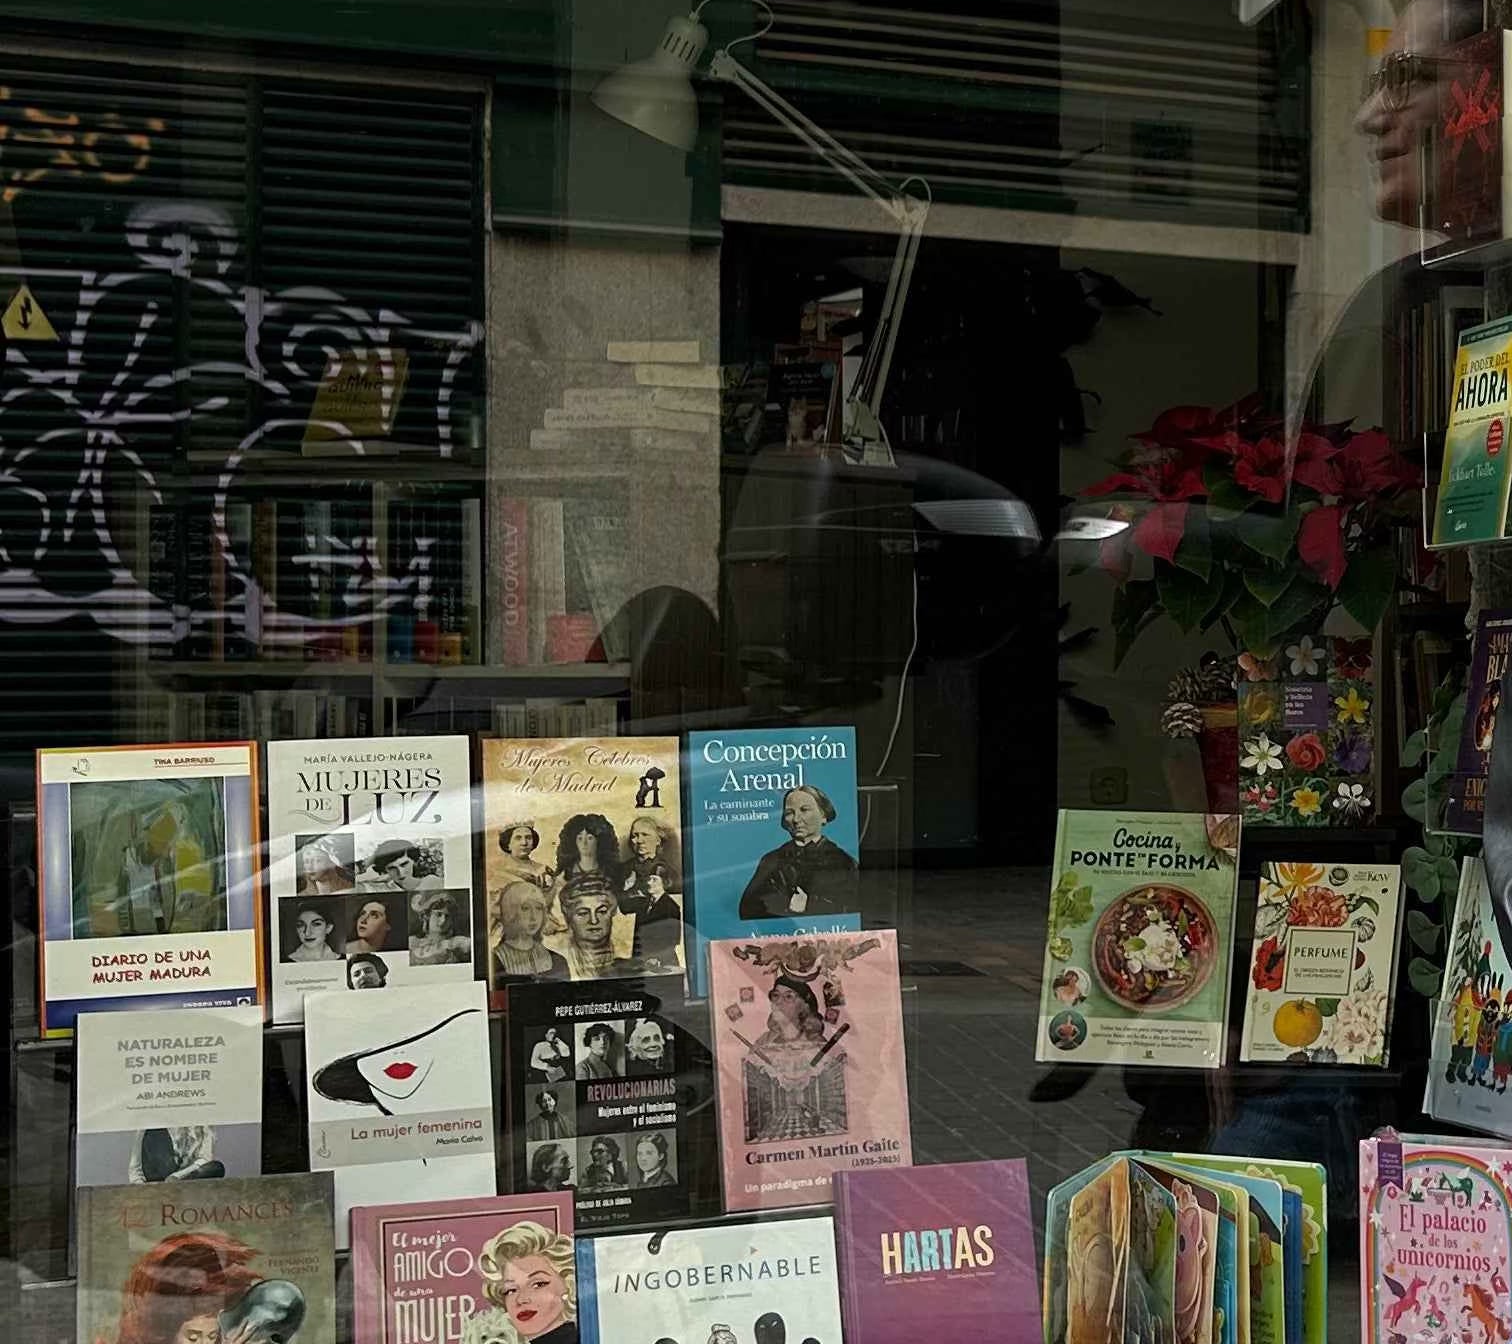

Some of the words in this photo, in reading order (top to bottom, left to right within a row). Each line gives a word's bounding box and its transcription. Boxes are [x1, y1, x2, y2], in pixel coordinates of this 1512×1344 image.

[1455, 368, 1508, 412] AHORA
[503, 519, 520, 626] ATWOOD
[304, 752, 337, 764] MARÍA
[703, 734, 847, 773] Concepción
[296, 767, 442, 793] MUJERES
[512, 778, 534, 794] de
[541, 775, 617, 794] Madrid
[719, 764, 805, 792] Arenal
[305, 798, 332, 812] DE
[338, 790, 442, 825] LUZ
[704, 799, 724, 810] La
[728, 798, 775, 810] caminante
[733, 810, 769, 822] sombra
[1113, 827, 1174, 848] Cocina
[1070, 850, 1135, 867] PONTE
[1148, 853, 1220, 871] FORMA
[92, 953, 148, 968] DIARIO
[154, 951, 173, 964] DE
[179, 949, 211, 962] UNA
[1294, 946, 1348, 959] PERFUME
[92, 969, 143, 984] MUJER
[149, 966, 211, 981] MADURA
[555, 1006, 573, 1016] PEPE
[117, 1036, 226, 1052] NATURALEZA
[125, 1055, 144, 1068] ES
[149, 1053, 218, 1067] NOMBRE
[132, 1072, 153, 1085] DE
[157, 1070, 211, 1084] MUJER
[155, 1088, 206, 1100] ANDREWS
[587, 1078, 676, 1102] REVOLUCIONARIAS
[351, 1127, 368, 1140] La
[373, 1125, 413, 1139] mujer
[417, 1118, 483, 1135] femenina
[745, 1149, 805, 1167] Carmen
[862, 1137, 901, 1155] Gaite
[744, 1183, 760, 1194] Un
[760, 1177, 813, 1194] paradigma
[815, 1175, 828, 1186] de
[1400, 1204, 1415, 1233] El
[1421, 1206, 1488, 1236] palacio
[392, 1232, 407, 1248] El
[411, 1230, 457, 1249] mejor
[881, 1225, 995, 1274] HARTAS
[1428, 1233, 1442, 1248] de
[1443, 1234, 1459, 1249] los
[394, 1247, 474, 1282] AMIGO
[1396, 1247, 1492, 1273] unicornios
[614, 1255, 823, 1294] INGOBERNABLE
